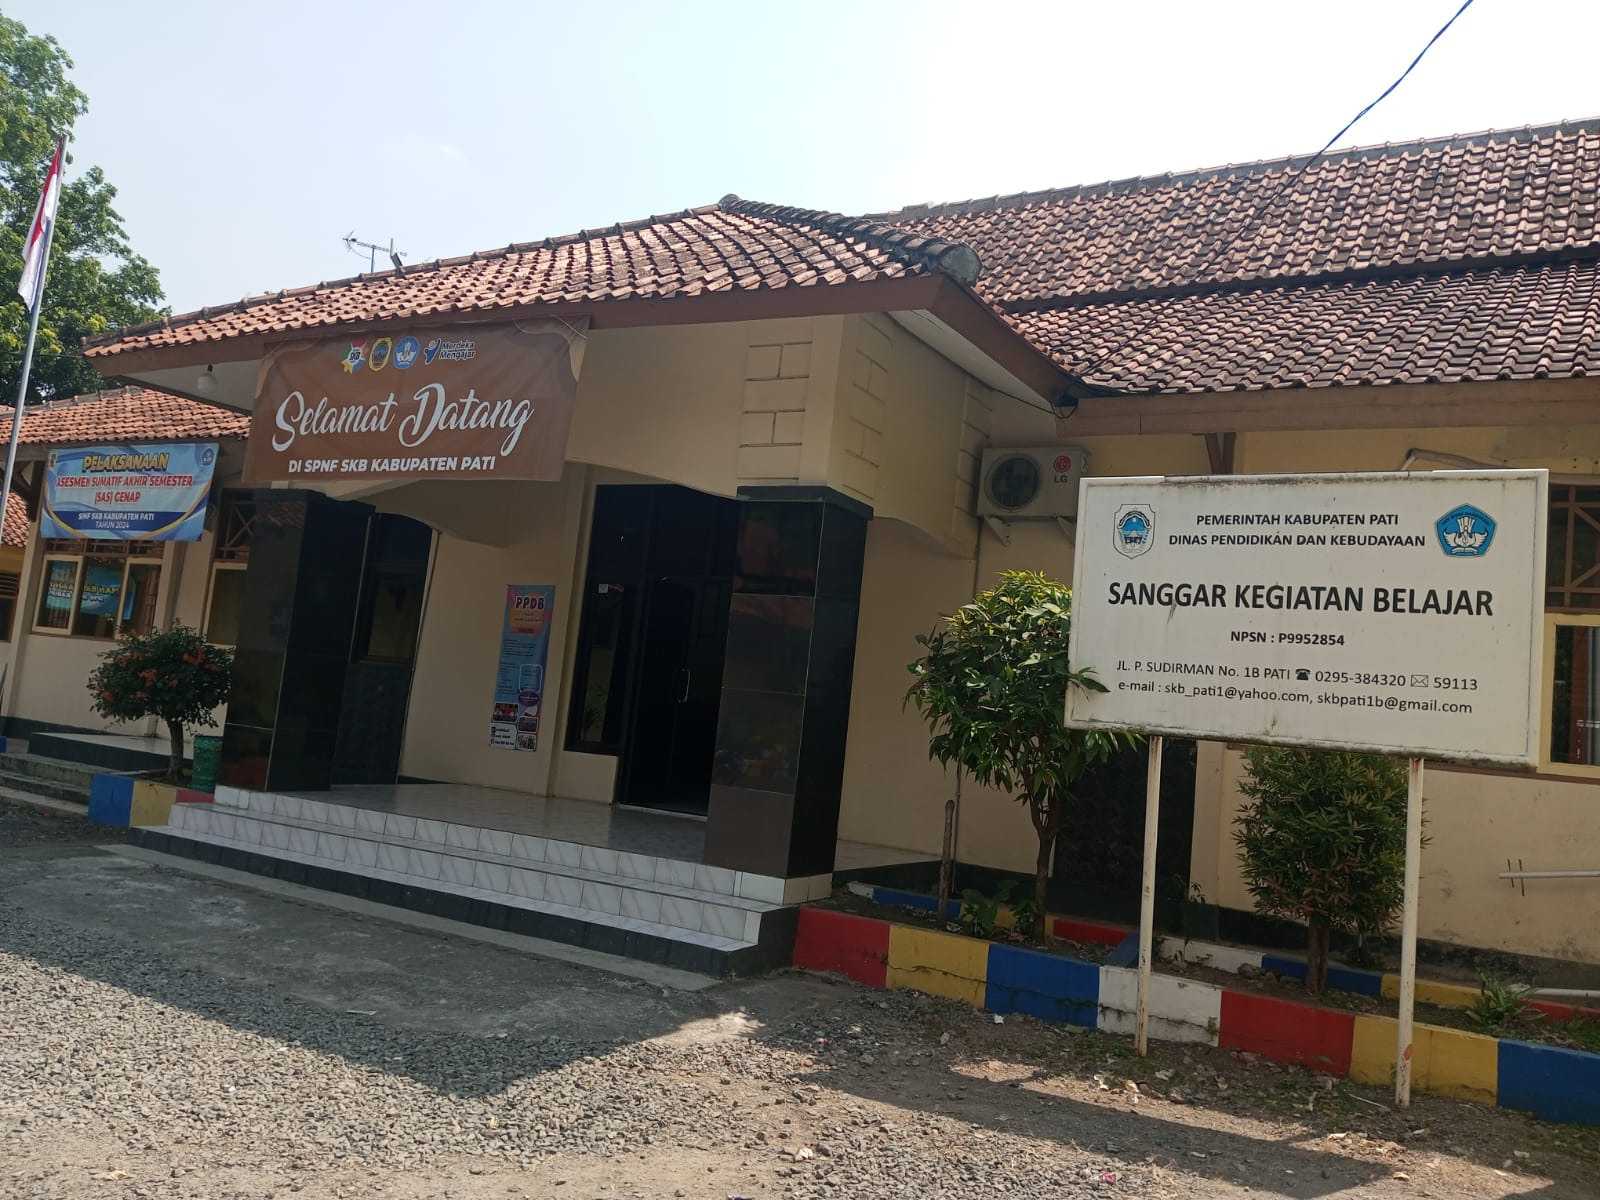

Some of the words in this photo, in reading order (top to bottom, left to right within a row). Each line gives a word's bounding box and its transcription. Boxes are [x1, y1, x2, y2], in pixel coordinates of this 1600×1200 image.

[442, 341, 475, 350] Merdeka
[440, 350, 476, 361] Mengajar
[272, 391, 398, 452] Selamat
[399, 383, 535, 456] Datang
[82, 453, 169, 473] PELAKSANAAN
[288, 460, 301, 473] DI
[304, 459, 338, 473] SPNF
[340, 459, 369, 472] SKB
[370, 458, 458, 472] KABUPATEN
[461, 456, 496, 471] PATI
[56, 476, 89, 488] ASESMEN
[91, 476, 122, 487] SUMATIF
[123, 475, 148, 487] AKHIR
[149, 475, 193, 487] SEMESTER
[1054, 475, 1068, 483] LG
[114, 491, 141, 502] GENAP
[91, 512, 103, 520] SKB
[1196, 513, 1281, 526] PEMERINTAH
[1284, 513, 1366, 526] KABUPATEN
[1369, 513, 1399, 526] PATI
[95, 521, 115, 529] TAHUN
[115, 521, 130, 529] 2024
[1168, 534, 1208, 546] DINAS
[1210, 534, 1293, 546] PENDIDIKAN
[1296, 534, 1327, 546] DAN
[1330, 534, 1426, 547] KEBUDAYAAN
[515, 595, 545, 610] PPDB
[1108, 581, 1227, 608] SANGGAR
[1235, 584, 1364, 612] KEGIATAN
[1373, 587, 1494, 617] BELAJAR
[1230, 630, 1267, 643] NPSN
[1278, 632, 1345, 647] P9952854
[1116, 660, 1131, 671] JL.
[1134, 661, 1143, 672] P.
[1146, 661, 1215, 676] SUDIRMAN
[1218, 665, 1240, 677] No.
[1244, 667, 1261, 678] 1B
[1263, 667, 1291, 680] PATI
[1315, 671, 1407, 687] 0295-384320
[1433, 677, 1478, 691] 59113
[1118, 681, 1155, 692] e-mail
[1165, 682, 1313, 704] skb_pati1@yahoo.com,
[1317, 692, 1473, 713] skbpati1b@gmail.com
